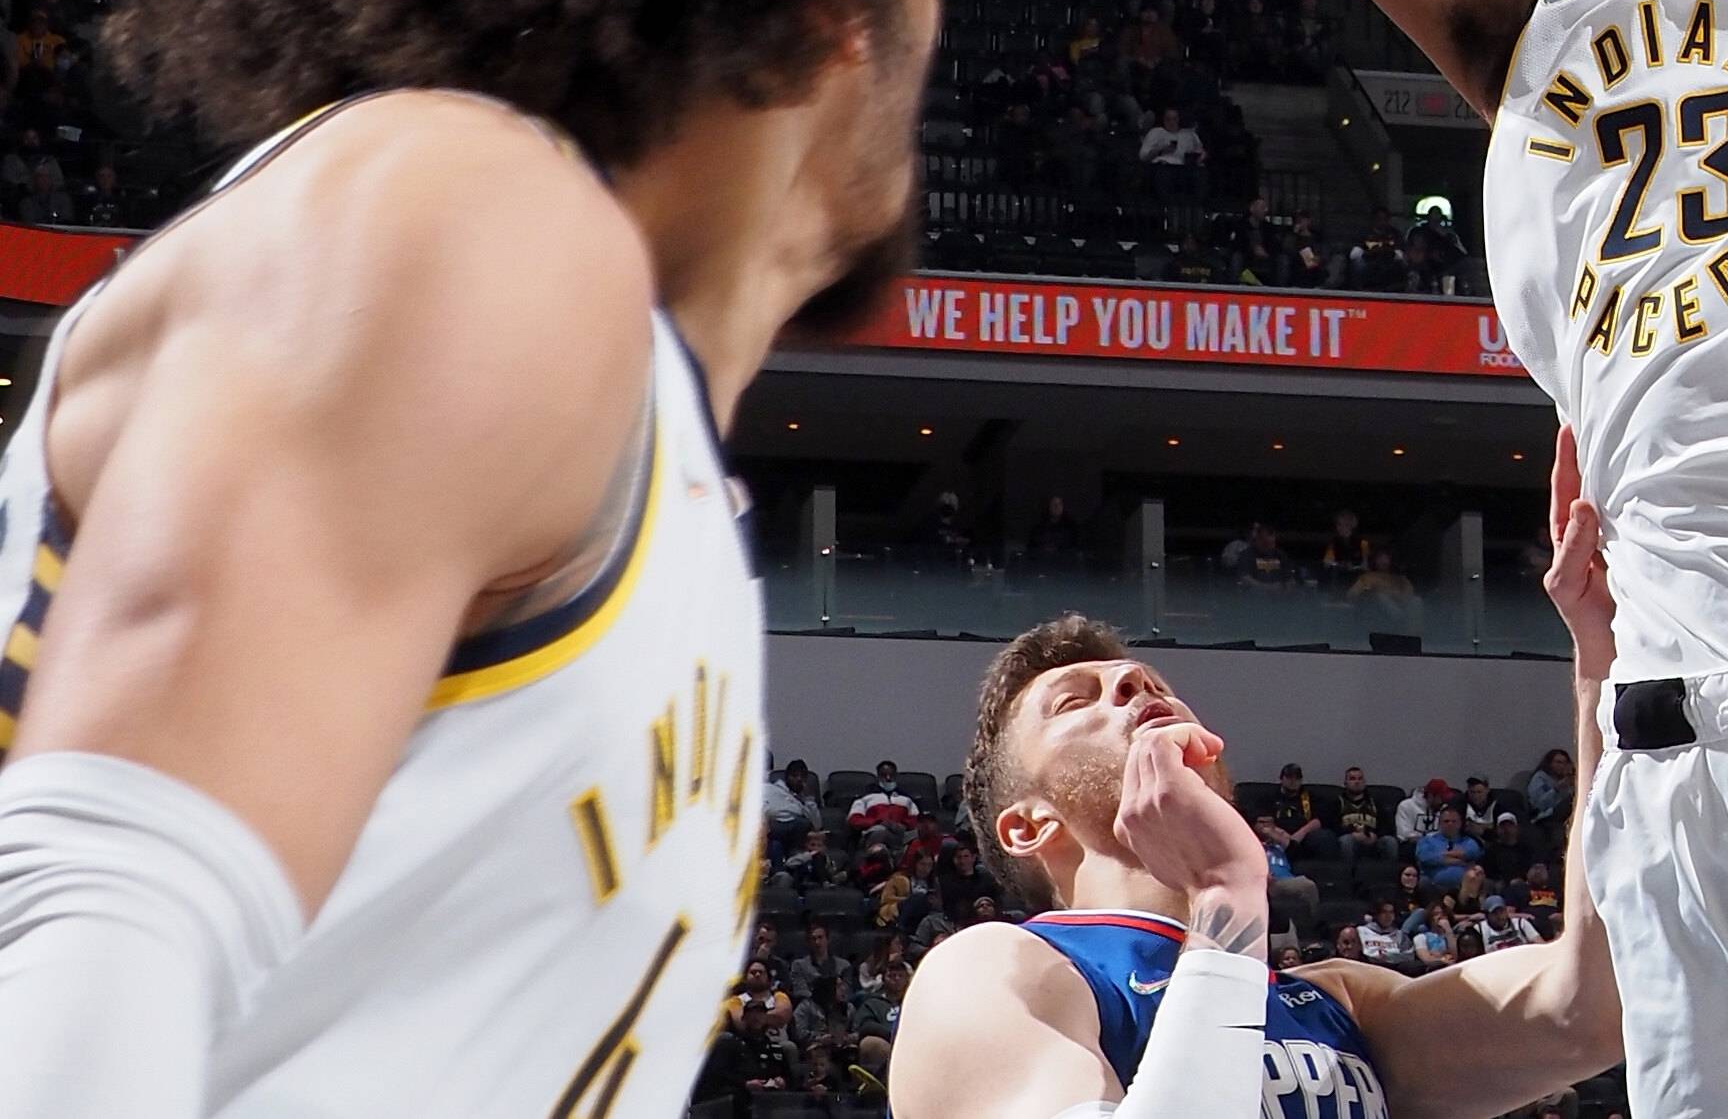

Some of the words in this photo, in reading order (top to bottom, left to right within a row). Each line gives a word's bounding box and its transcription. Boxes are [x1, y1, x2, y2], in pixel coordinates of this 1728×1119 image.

[905, 288, 967, 341] WE
[979, 291, 1080, 346] HELP
[1091, 296, 1172, 351] YOU
[1185, 300, 1297, 357] MAKE
